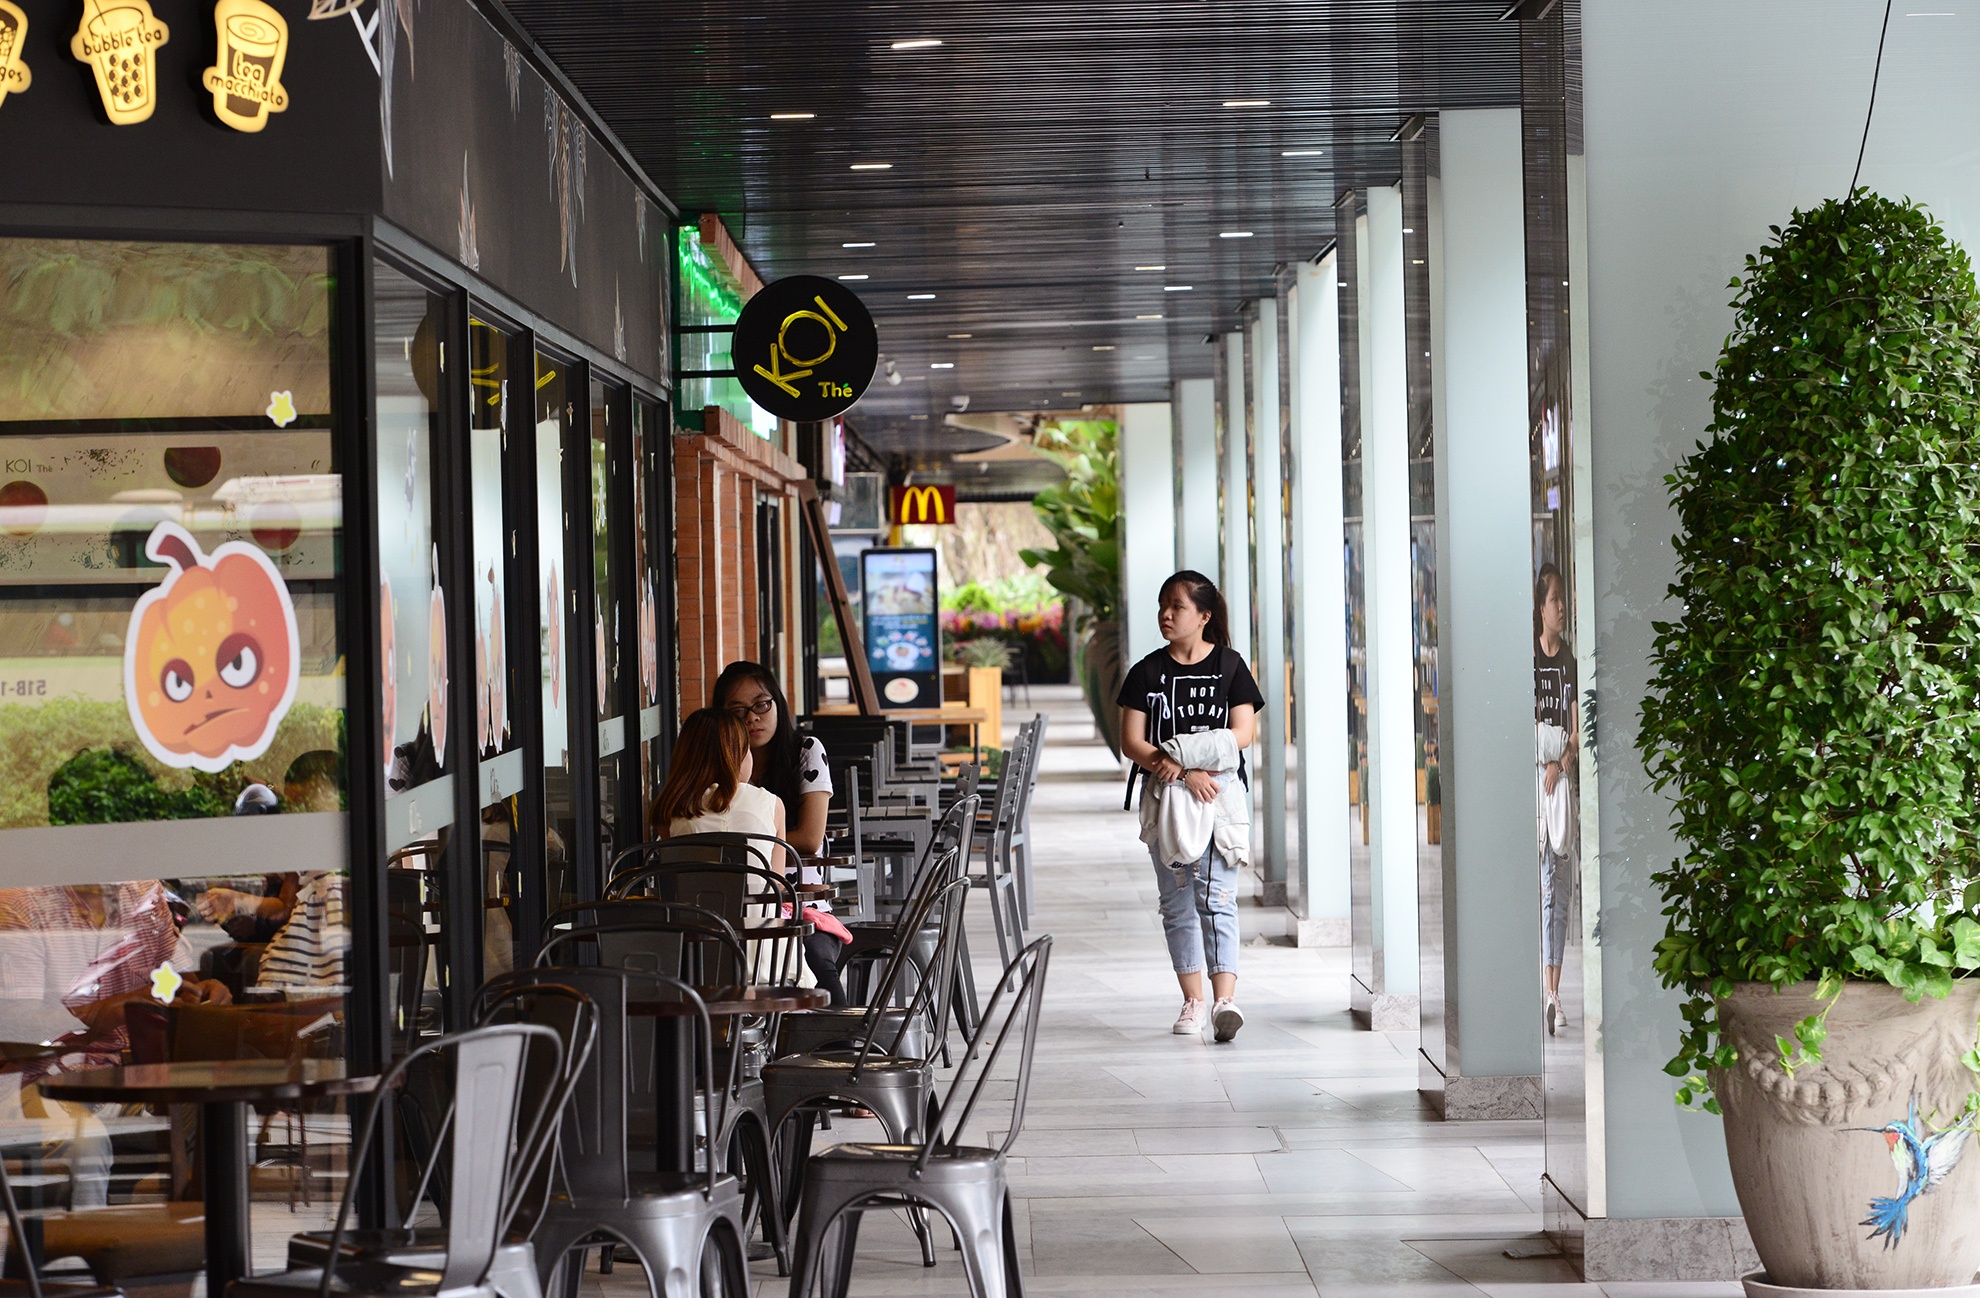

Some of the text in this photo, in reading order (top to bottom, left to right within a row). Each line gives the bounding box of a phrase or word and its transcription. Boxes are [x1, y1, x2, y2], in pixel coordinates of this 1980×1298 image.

[82, 26, 162, 56] bubble tea
[236, 53, 262, 80] tea
[210, 75, 284, 106] macchiato
[753, 295, 848, 398] KOI
[5, 458, 32, 473] KOI
[1190, 686, 1215, 698] NOT
[1177, 703, 1224, 719] TODAY
